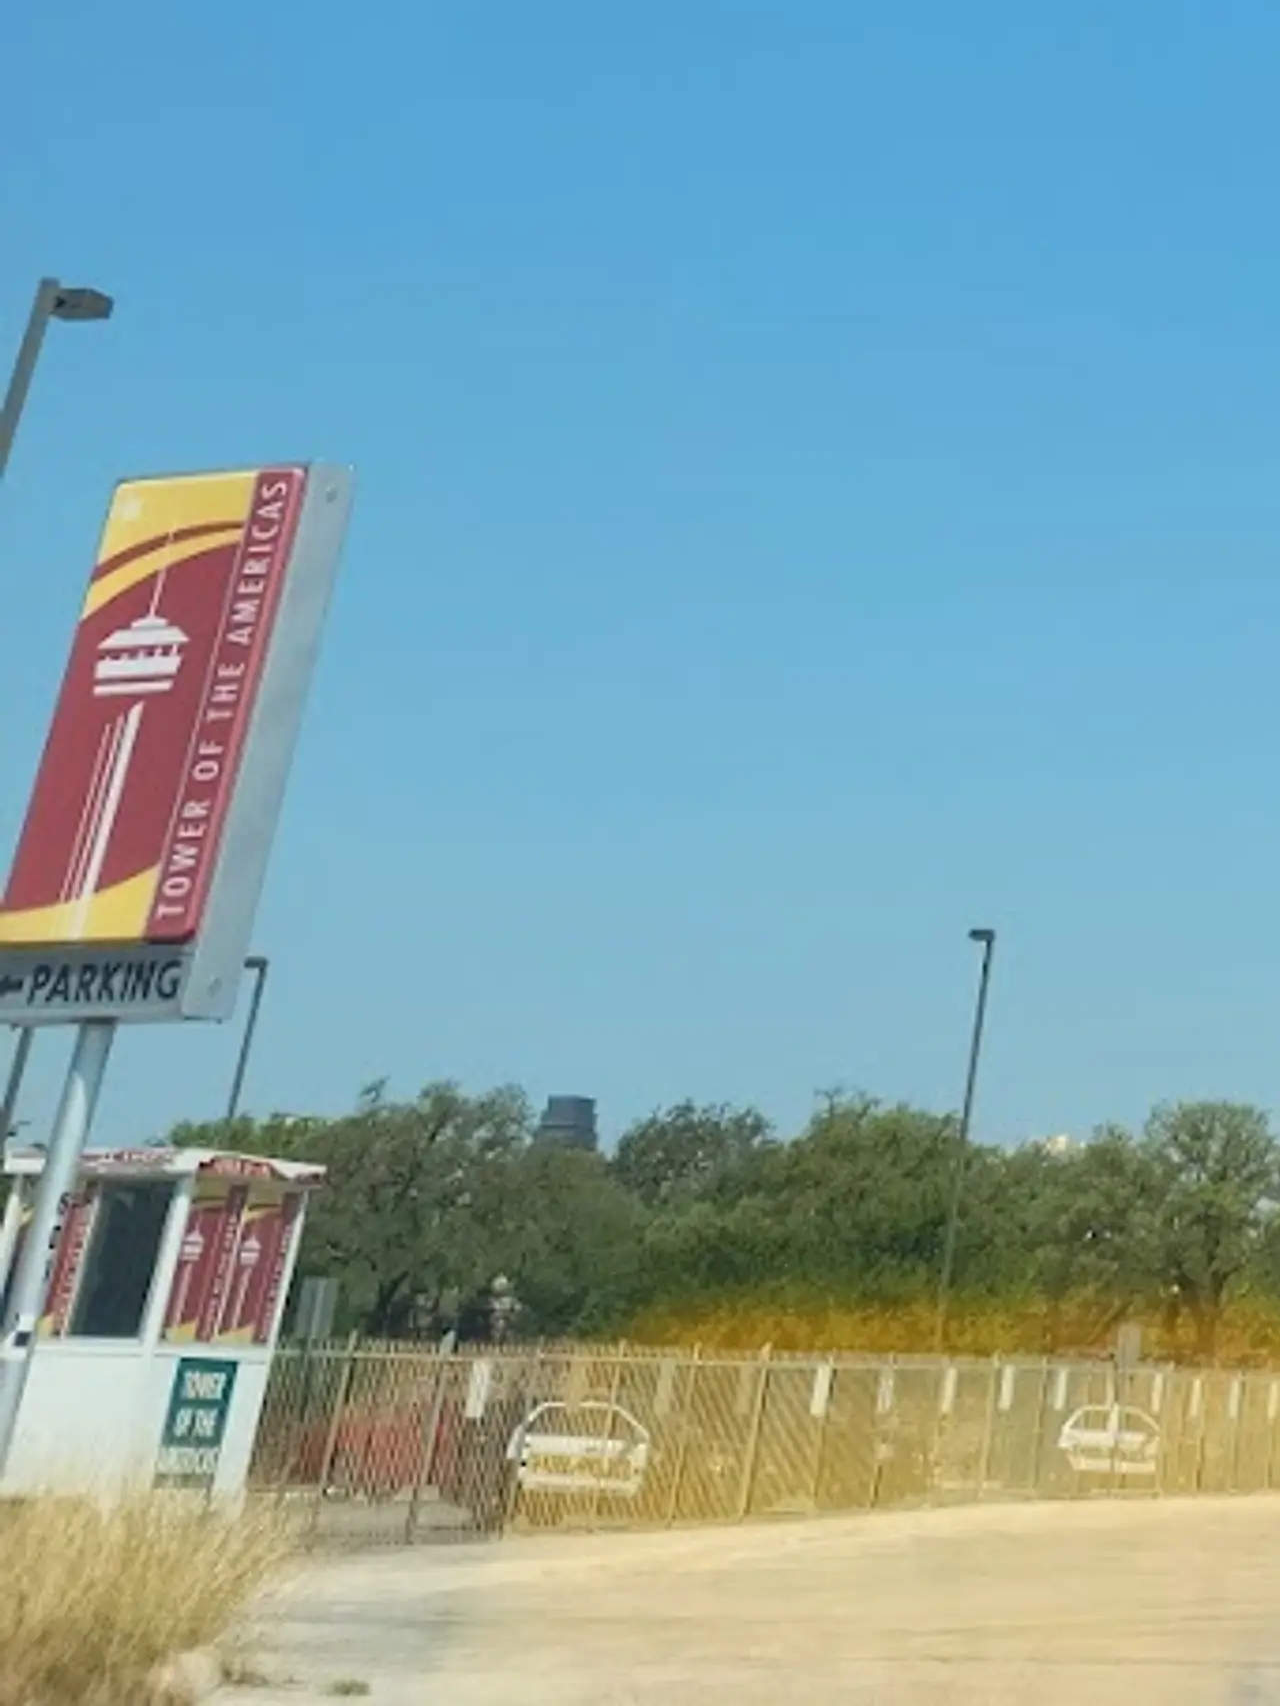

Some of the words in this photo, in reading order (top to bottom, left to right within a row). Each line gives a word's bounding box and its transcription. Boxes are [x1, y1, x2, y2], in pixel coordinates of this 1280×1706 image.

[226, 481, 287, 646] AMERICAS
[206, 662, 245, 723] THE
[192, 740, 223, 781] OF
[156, 799, 211, 920] TOWER
[26, 959, 183, 1006] PARKING
